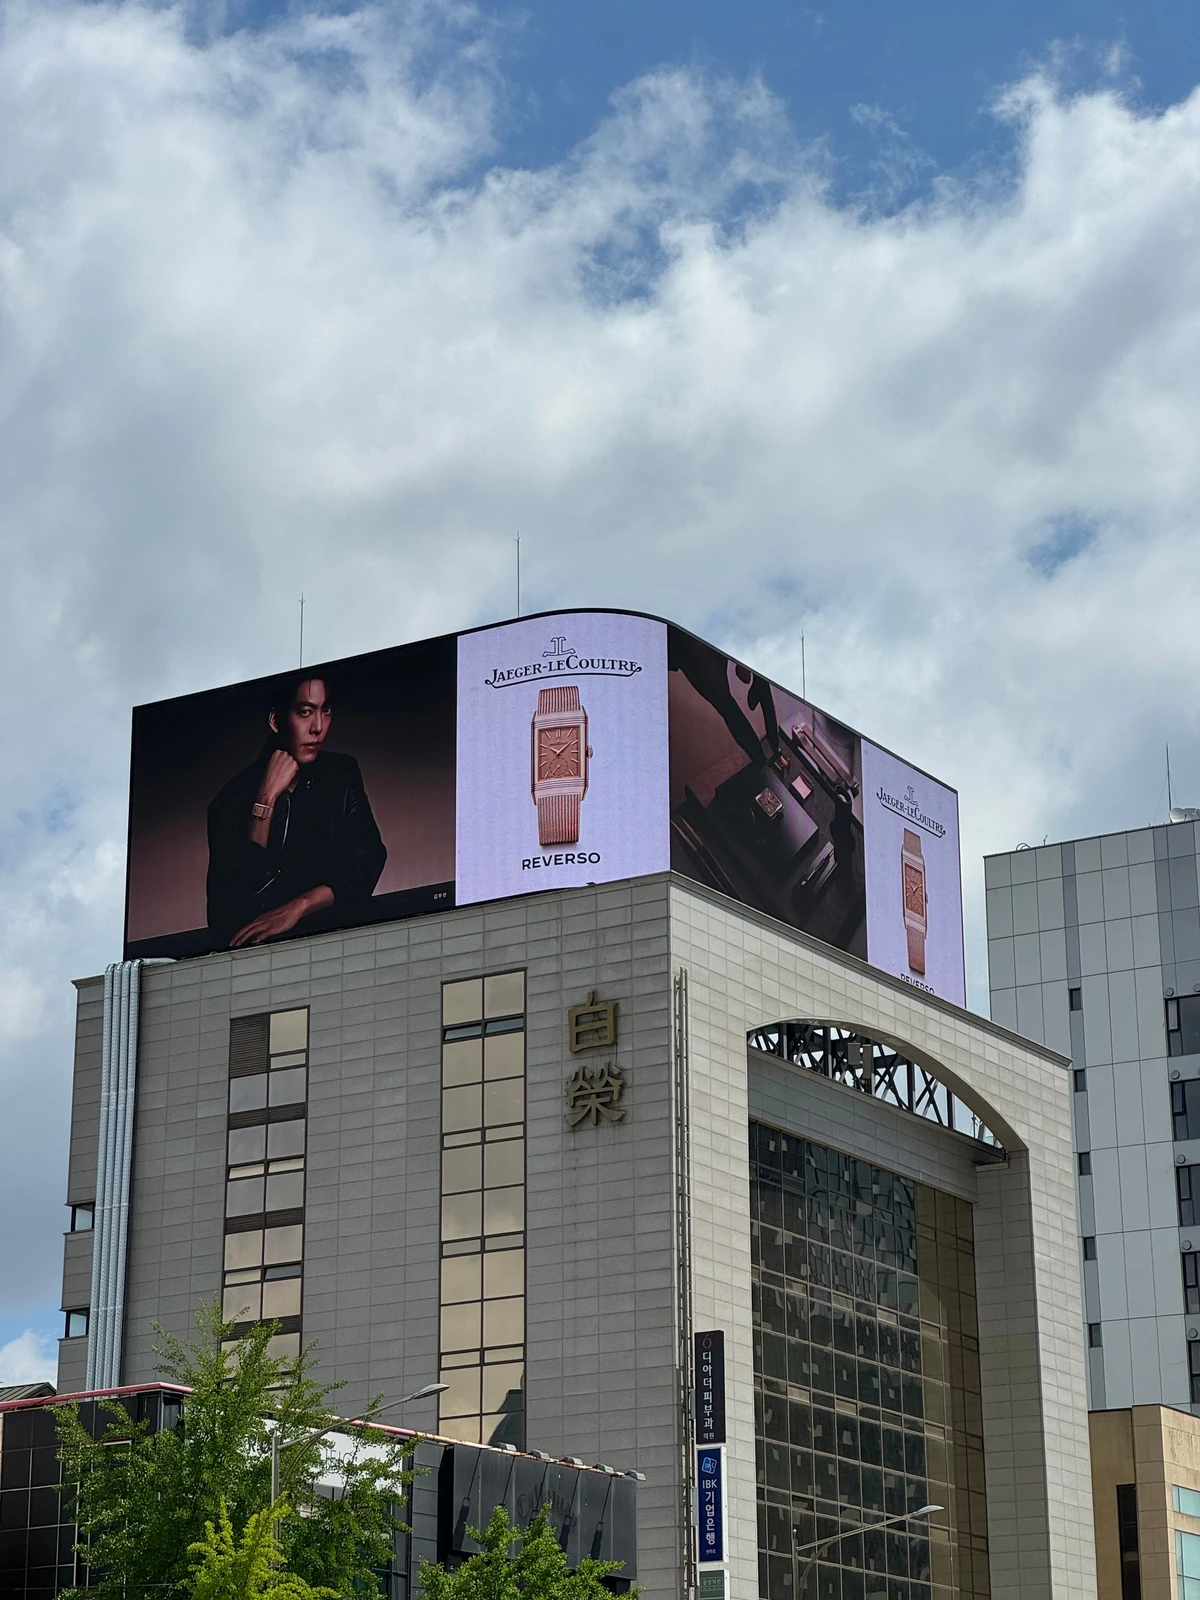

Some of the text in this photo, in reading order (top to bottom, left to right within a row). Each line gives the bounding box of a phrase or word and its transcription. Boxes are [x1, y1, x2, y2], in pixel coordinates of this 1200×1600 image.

[522, 852, 601, 870] REVERSO
[702, 1351, 714, 1429] 디아더피부과
[702, 1479, 718, 1545] IBK 기업은행
